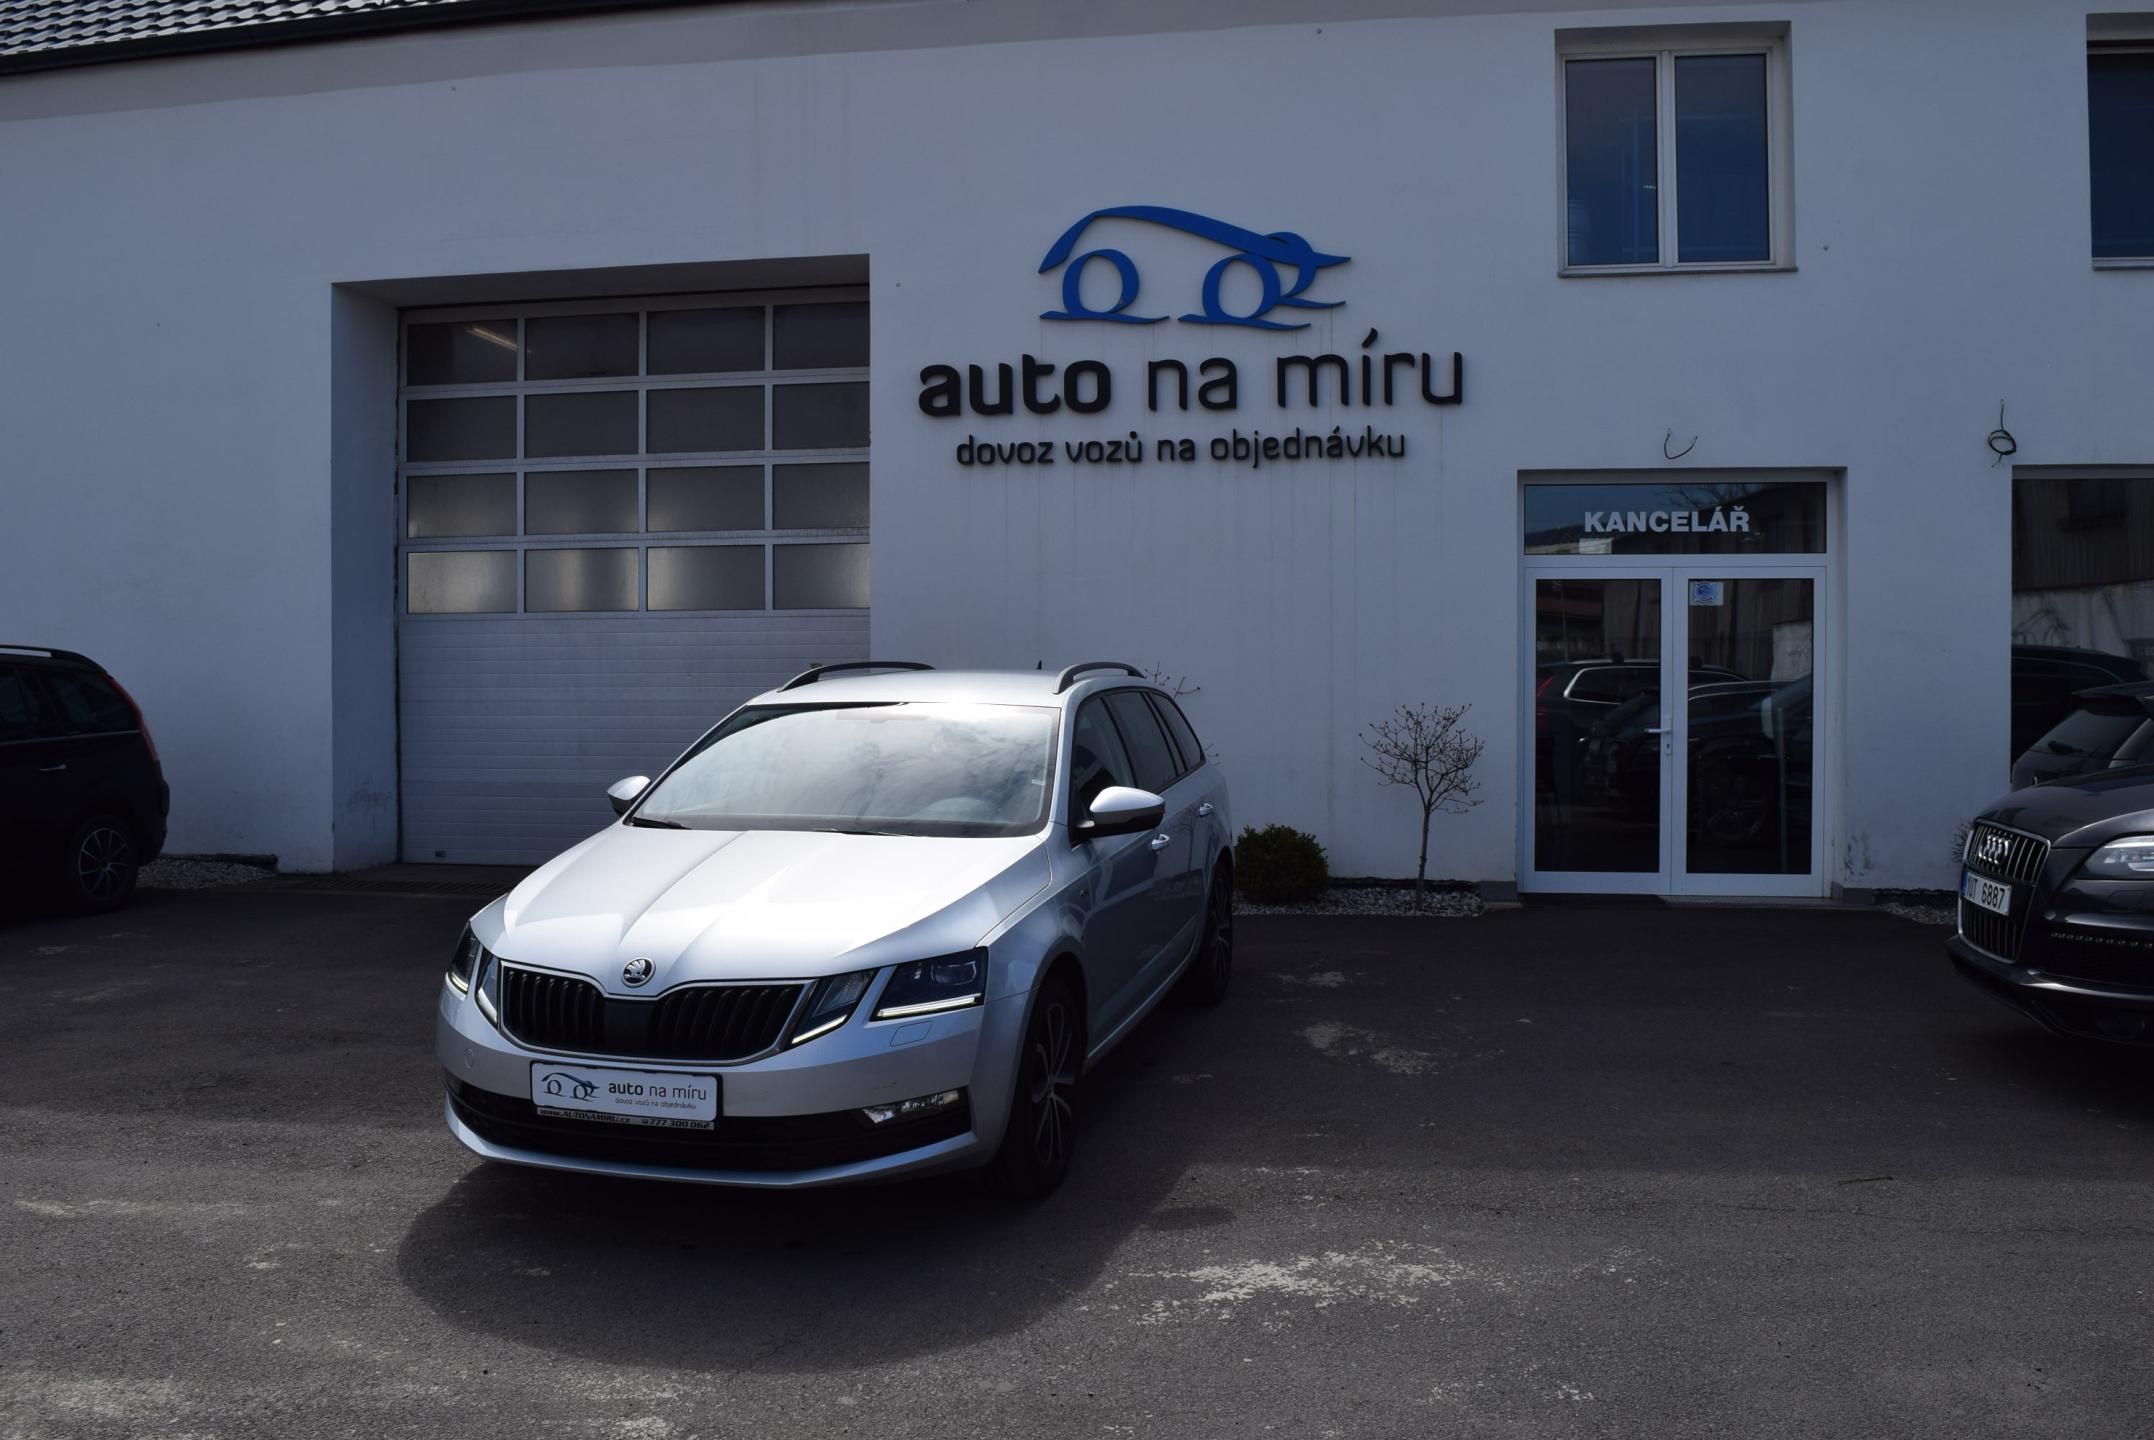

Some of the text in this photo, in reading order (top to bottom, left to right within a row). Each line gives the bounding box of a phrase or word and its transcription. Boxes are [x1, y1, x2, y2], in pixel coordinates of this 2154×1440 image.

[919, 327, 1463, 417] auto na míru
[956, 425, 1406, 469] dovoz vozů na objednávku
[1584, 505, 1751, 533] KANCELÁŘ
[1981, 882, 2005, 909] 6887
[608, 1082, 707, 1101] auto na míru
